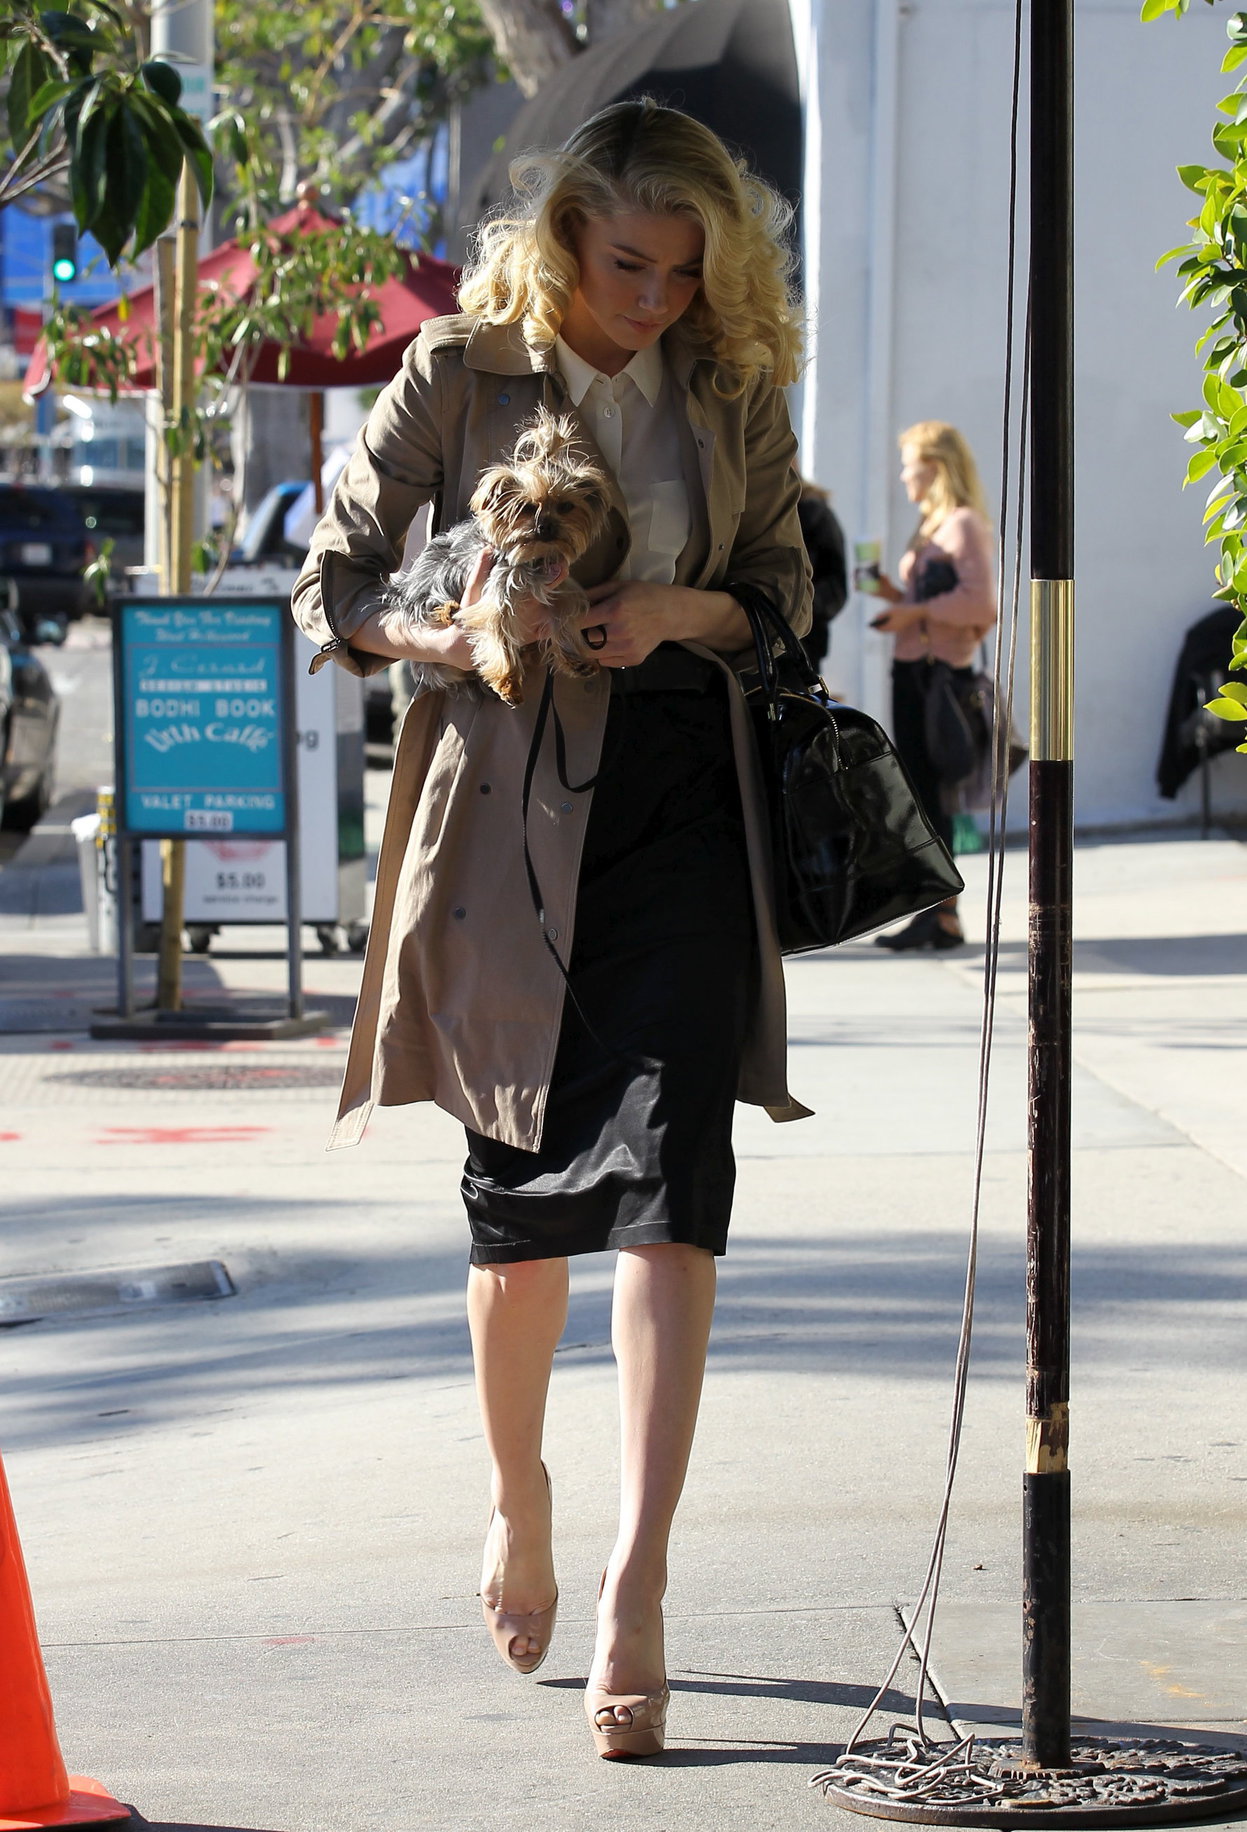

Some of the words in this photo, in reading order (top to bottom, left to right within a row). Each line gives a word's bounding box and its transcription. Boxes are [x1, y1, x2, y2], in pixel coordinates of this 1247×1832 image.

[135, 699, 200, 717] BODHI
[215, 699, 275, 717] BOOK
[141, 794, 192, 810] VALET
[204, 794, 276, 811] PARKING
